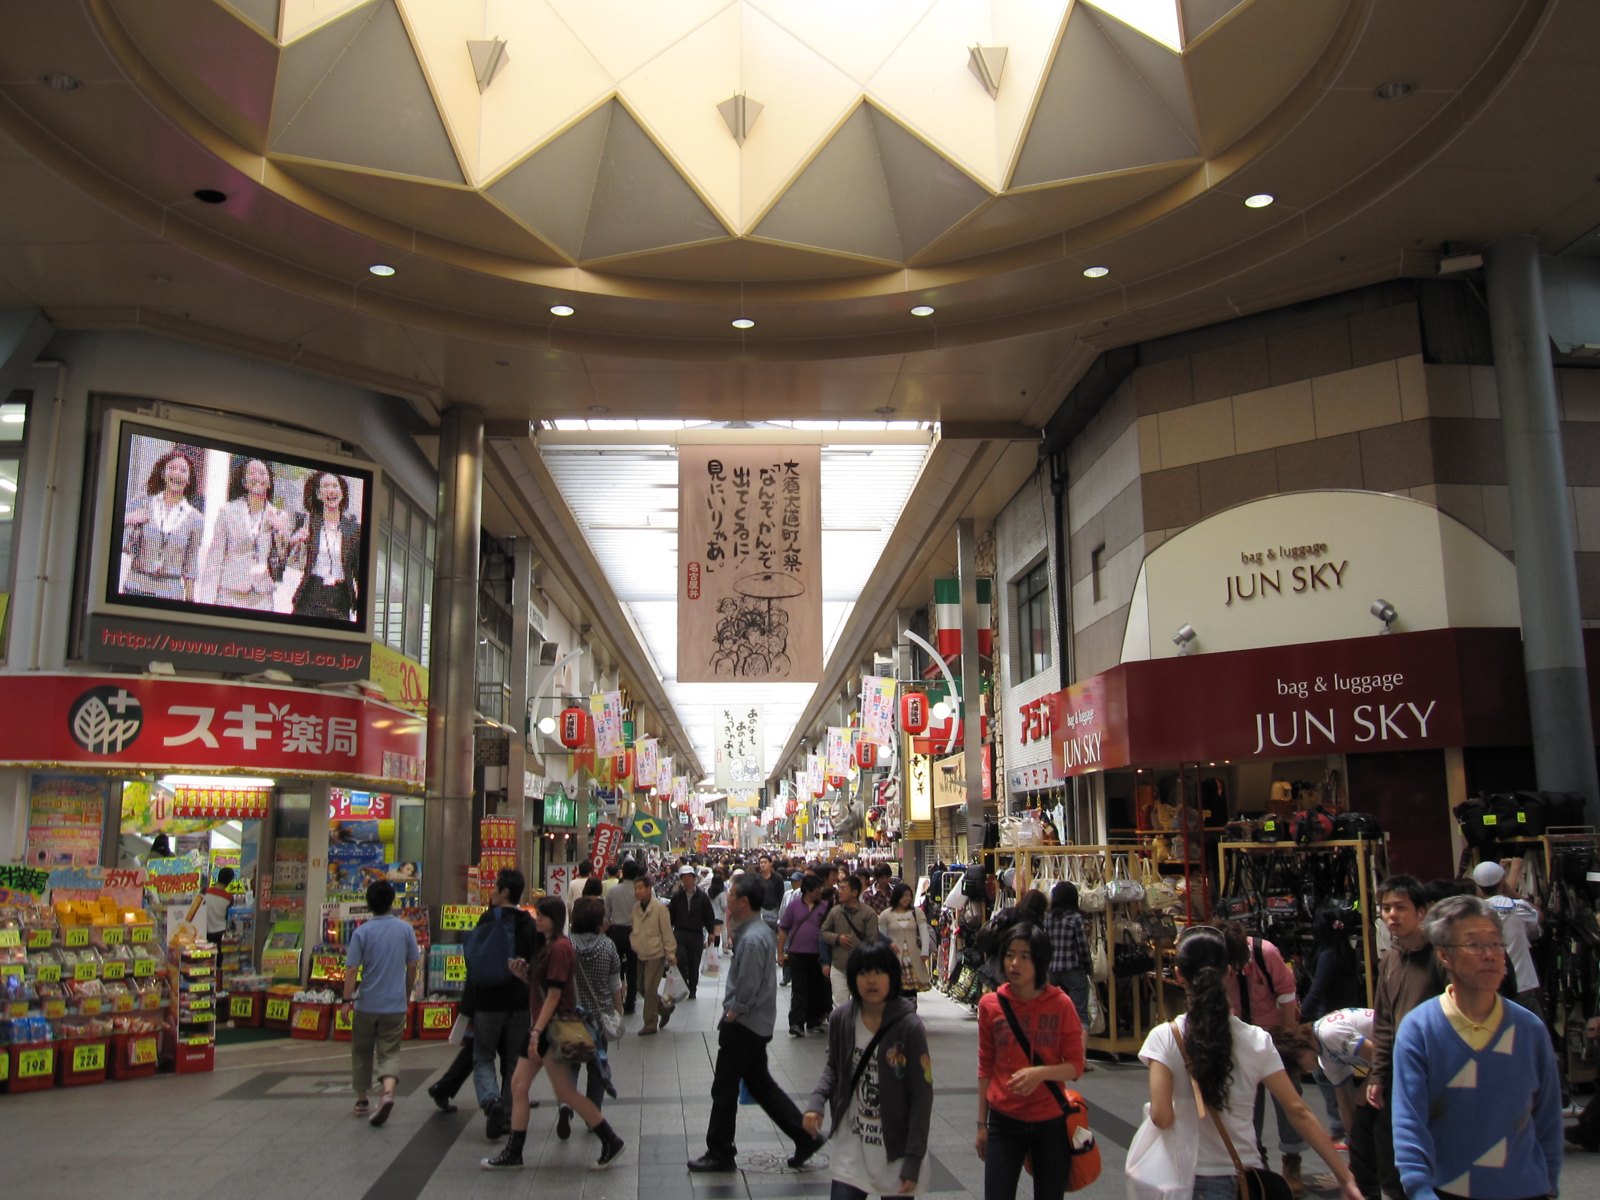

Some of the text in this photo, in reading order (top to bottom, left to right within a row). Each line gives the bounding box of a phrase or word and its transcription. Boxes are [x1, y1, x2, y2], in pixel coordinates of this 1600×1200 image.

[782, 459, 803, 572] 大須大道町人祭
[1240, 540, 1329, 565] bag & luggage
[1224, 560, 1349, 606] JUN SKY
[101, 628, 363, 671] http://www.drug-sugi.co.jp/
[1277, 671, 1404, 699] bag & luggage
[163, 702, 358, 758] スギ薬局
[1067, 713, 1075, 730] bag
[1079, 708, 1095, 726] luggage
[1253, 700, 1437, 755] JUN SKY
[1063, 732, 1102, 774] JUN SKY
[105, 869, 144, 888] おかし
[26, 1060, 46, 1073] 198
[80, 1055, 98, 1068] 228
